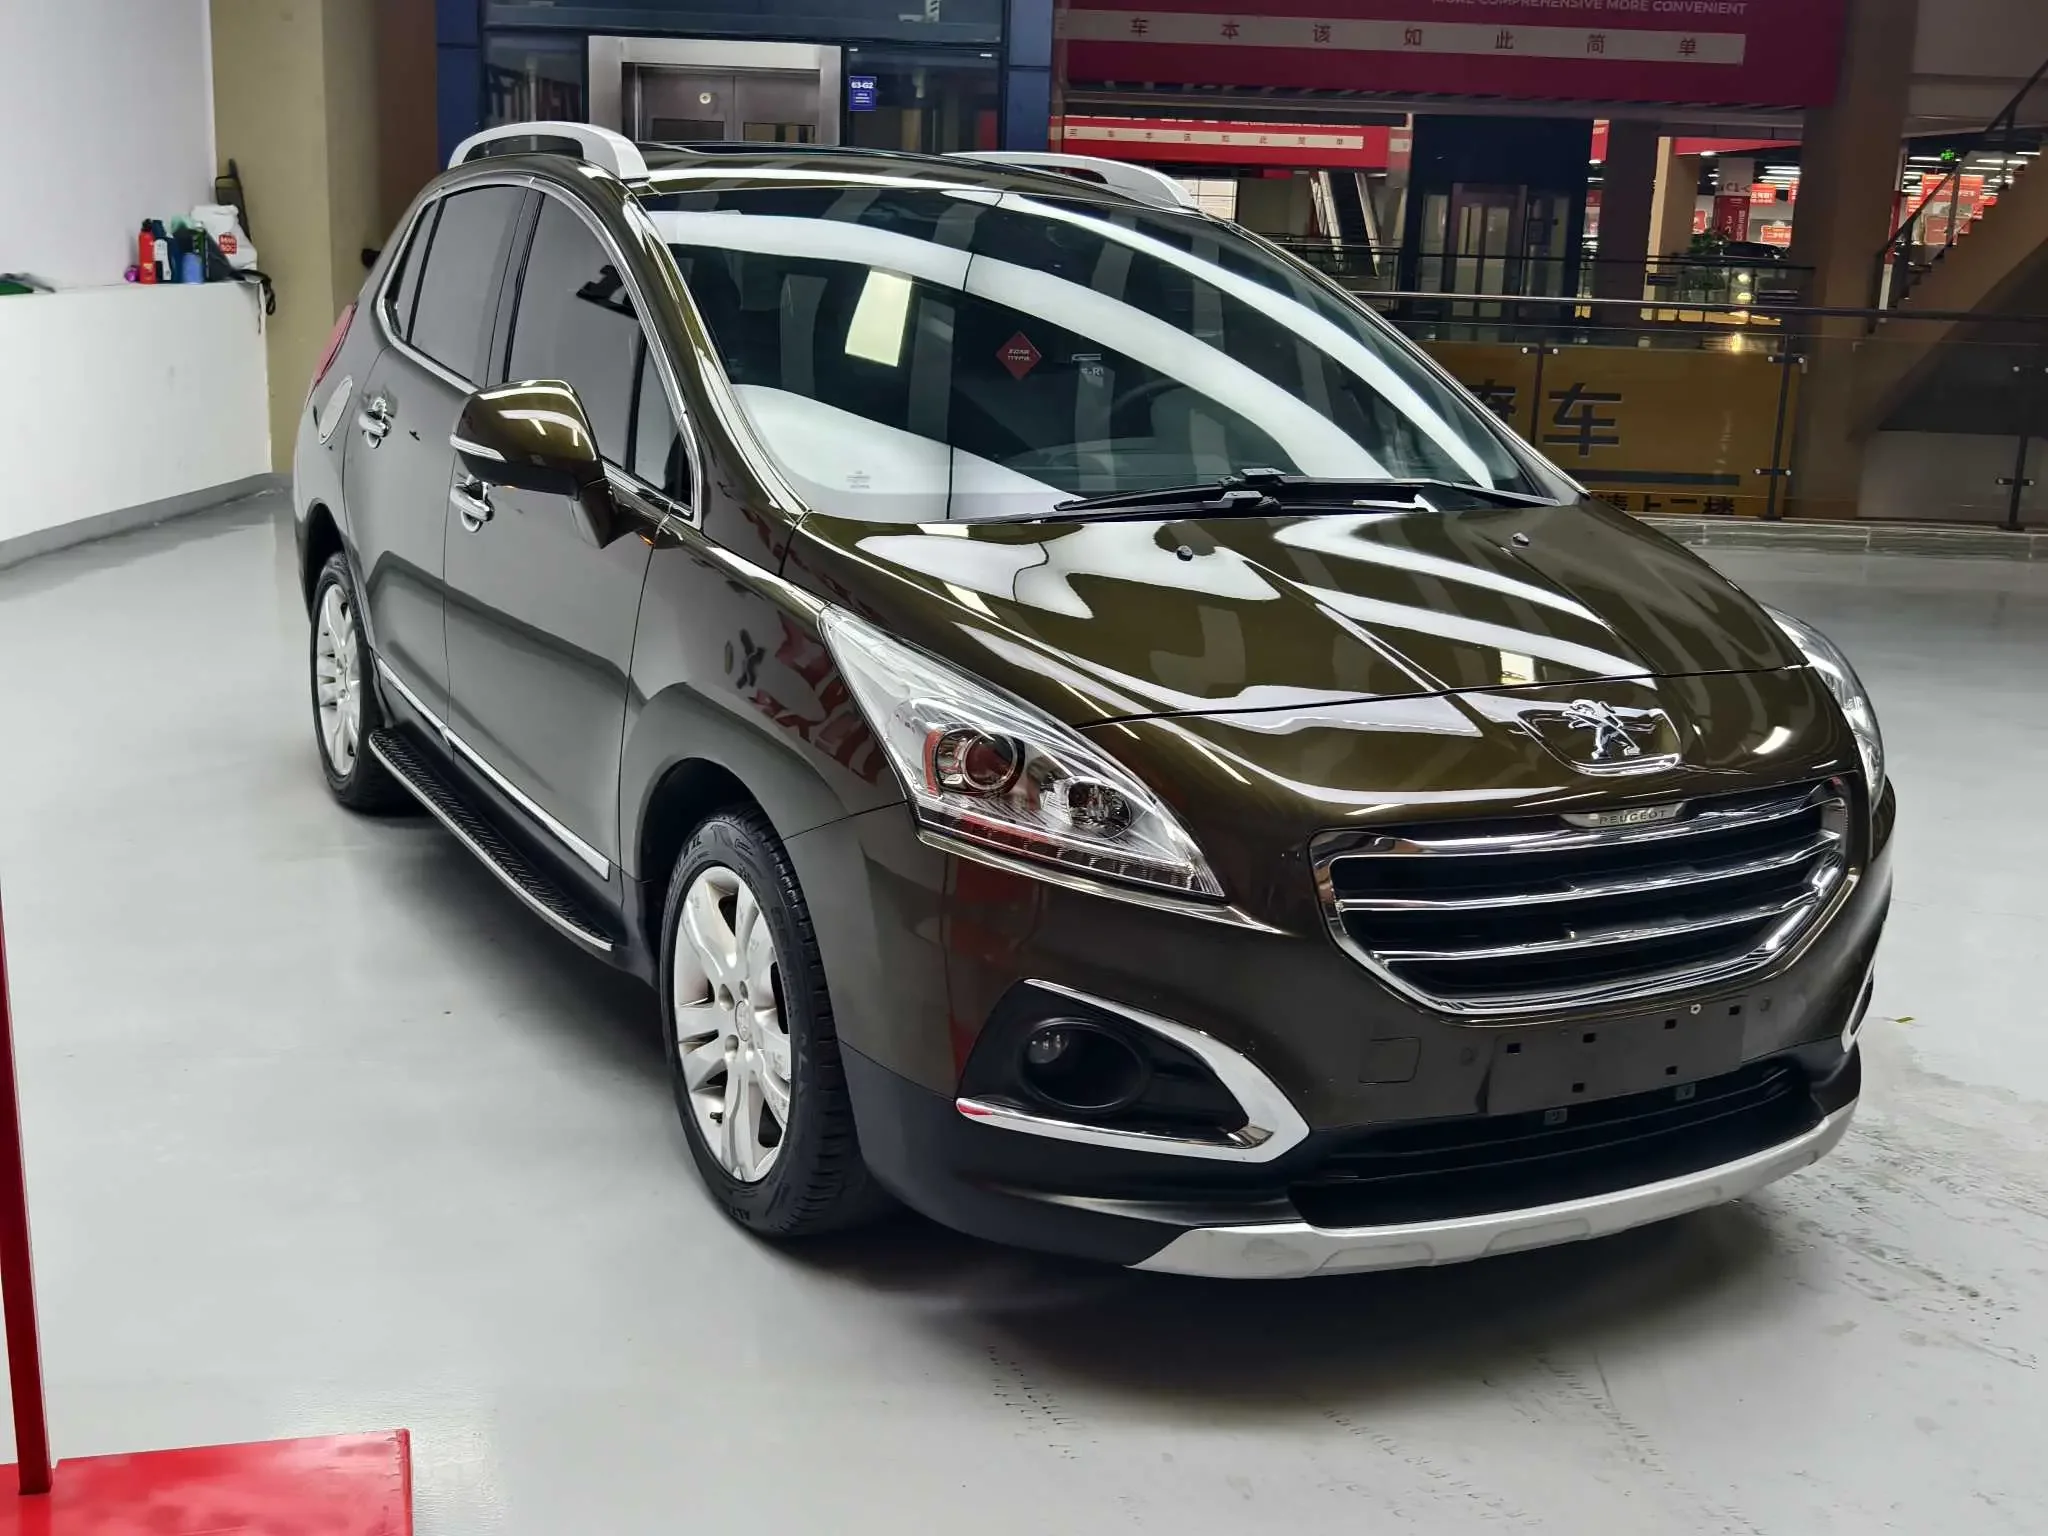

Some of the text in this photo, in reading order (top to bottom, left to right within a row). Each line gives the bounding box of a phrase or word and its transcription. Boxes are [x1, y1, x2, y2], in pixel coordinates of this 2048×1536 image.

[1606, 0, 1649, 12] MORE
[1652, 1, 1747, 15] CONVENIENT
[1130, 17, 1697, 56] 车本该如此简单
[1600, 809, 1666, 824] PEUGEOT
